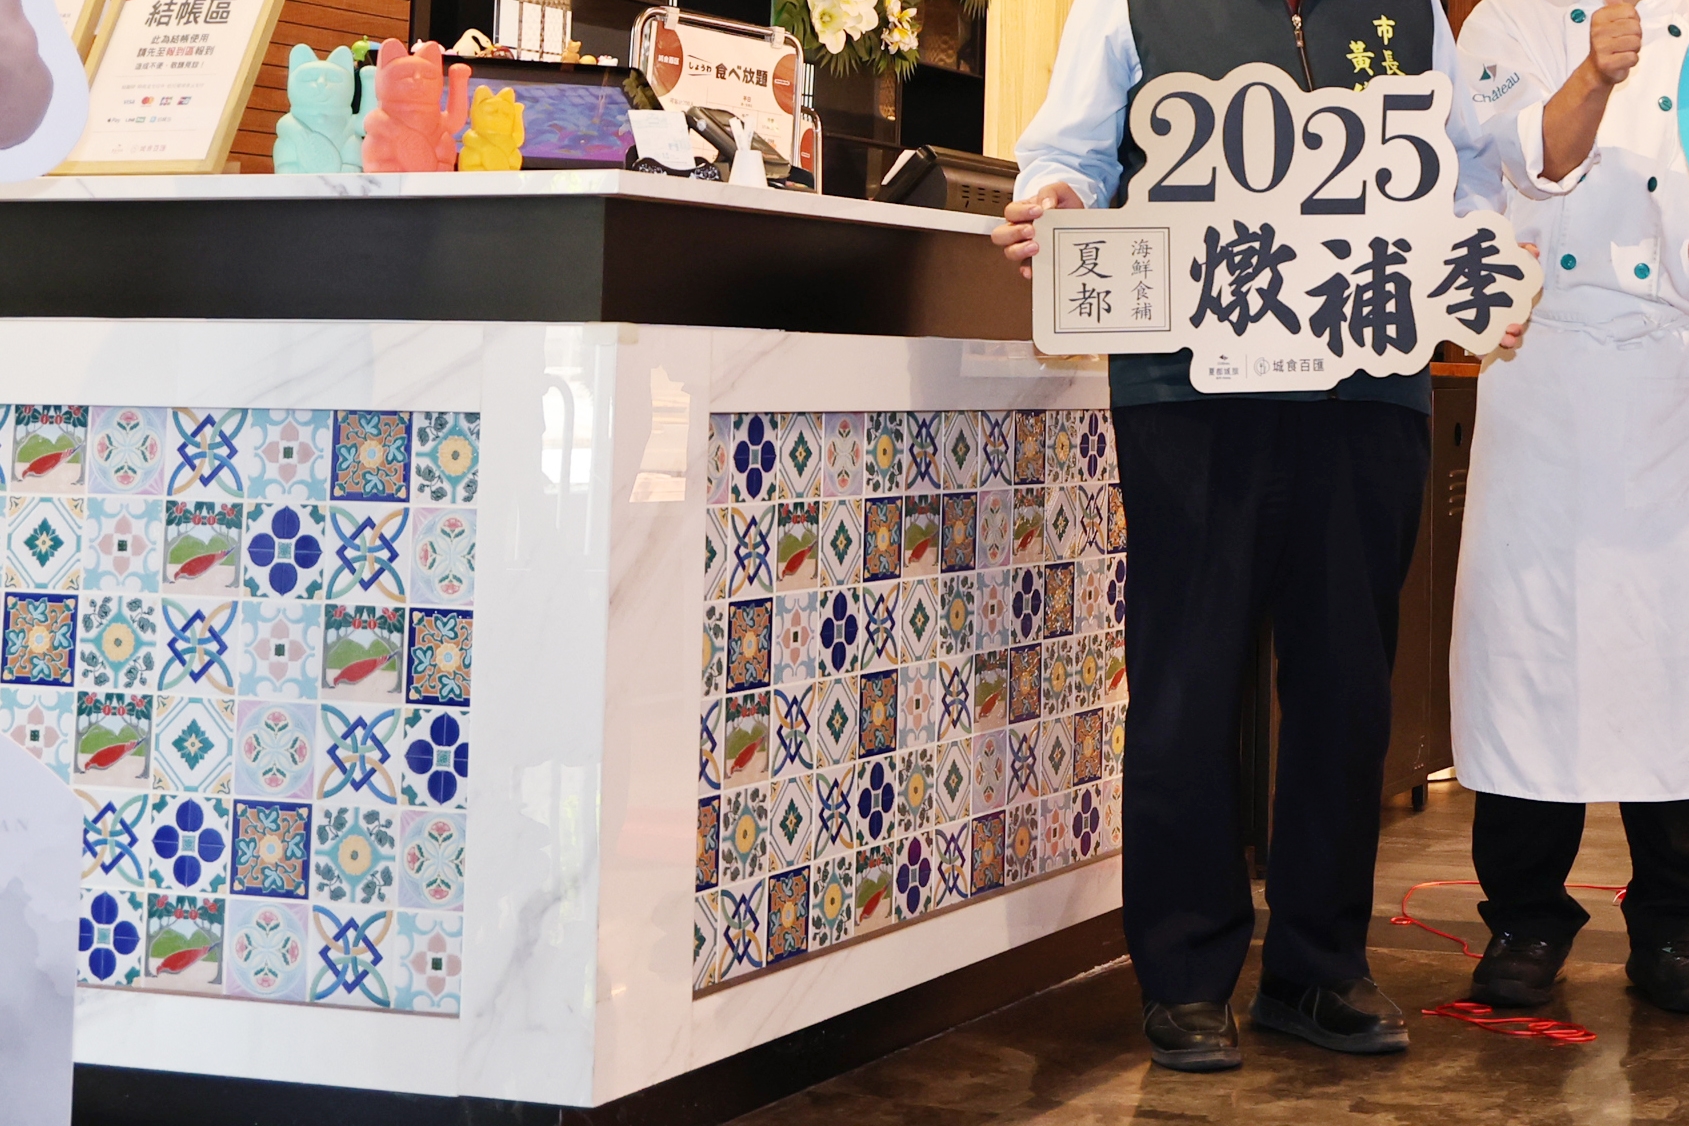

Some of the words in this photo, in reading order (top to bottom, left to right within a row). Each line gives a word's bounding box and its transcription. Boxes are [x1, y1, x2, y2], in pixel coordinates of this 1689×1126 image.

[689, 62, 712, 73] しょうわ
[715, 63, 768, 87] 食べ放題
[1346, 40, 1375, 92] 黃
[1372, 14, 1406, 76] 市長
[1472, 72, 1520, 103] Château
[1148, 82, 1440, 215] 2025
[1067, 240, 1113, 323] 夏都
[1131, 238, 1154, 321] 海鮮食補
[1189, 220, 1525, 358] 燉補季
[1273, 358, 1325, 373] 城食百匯
